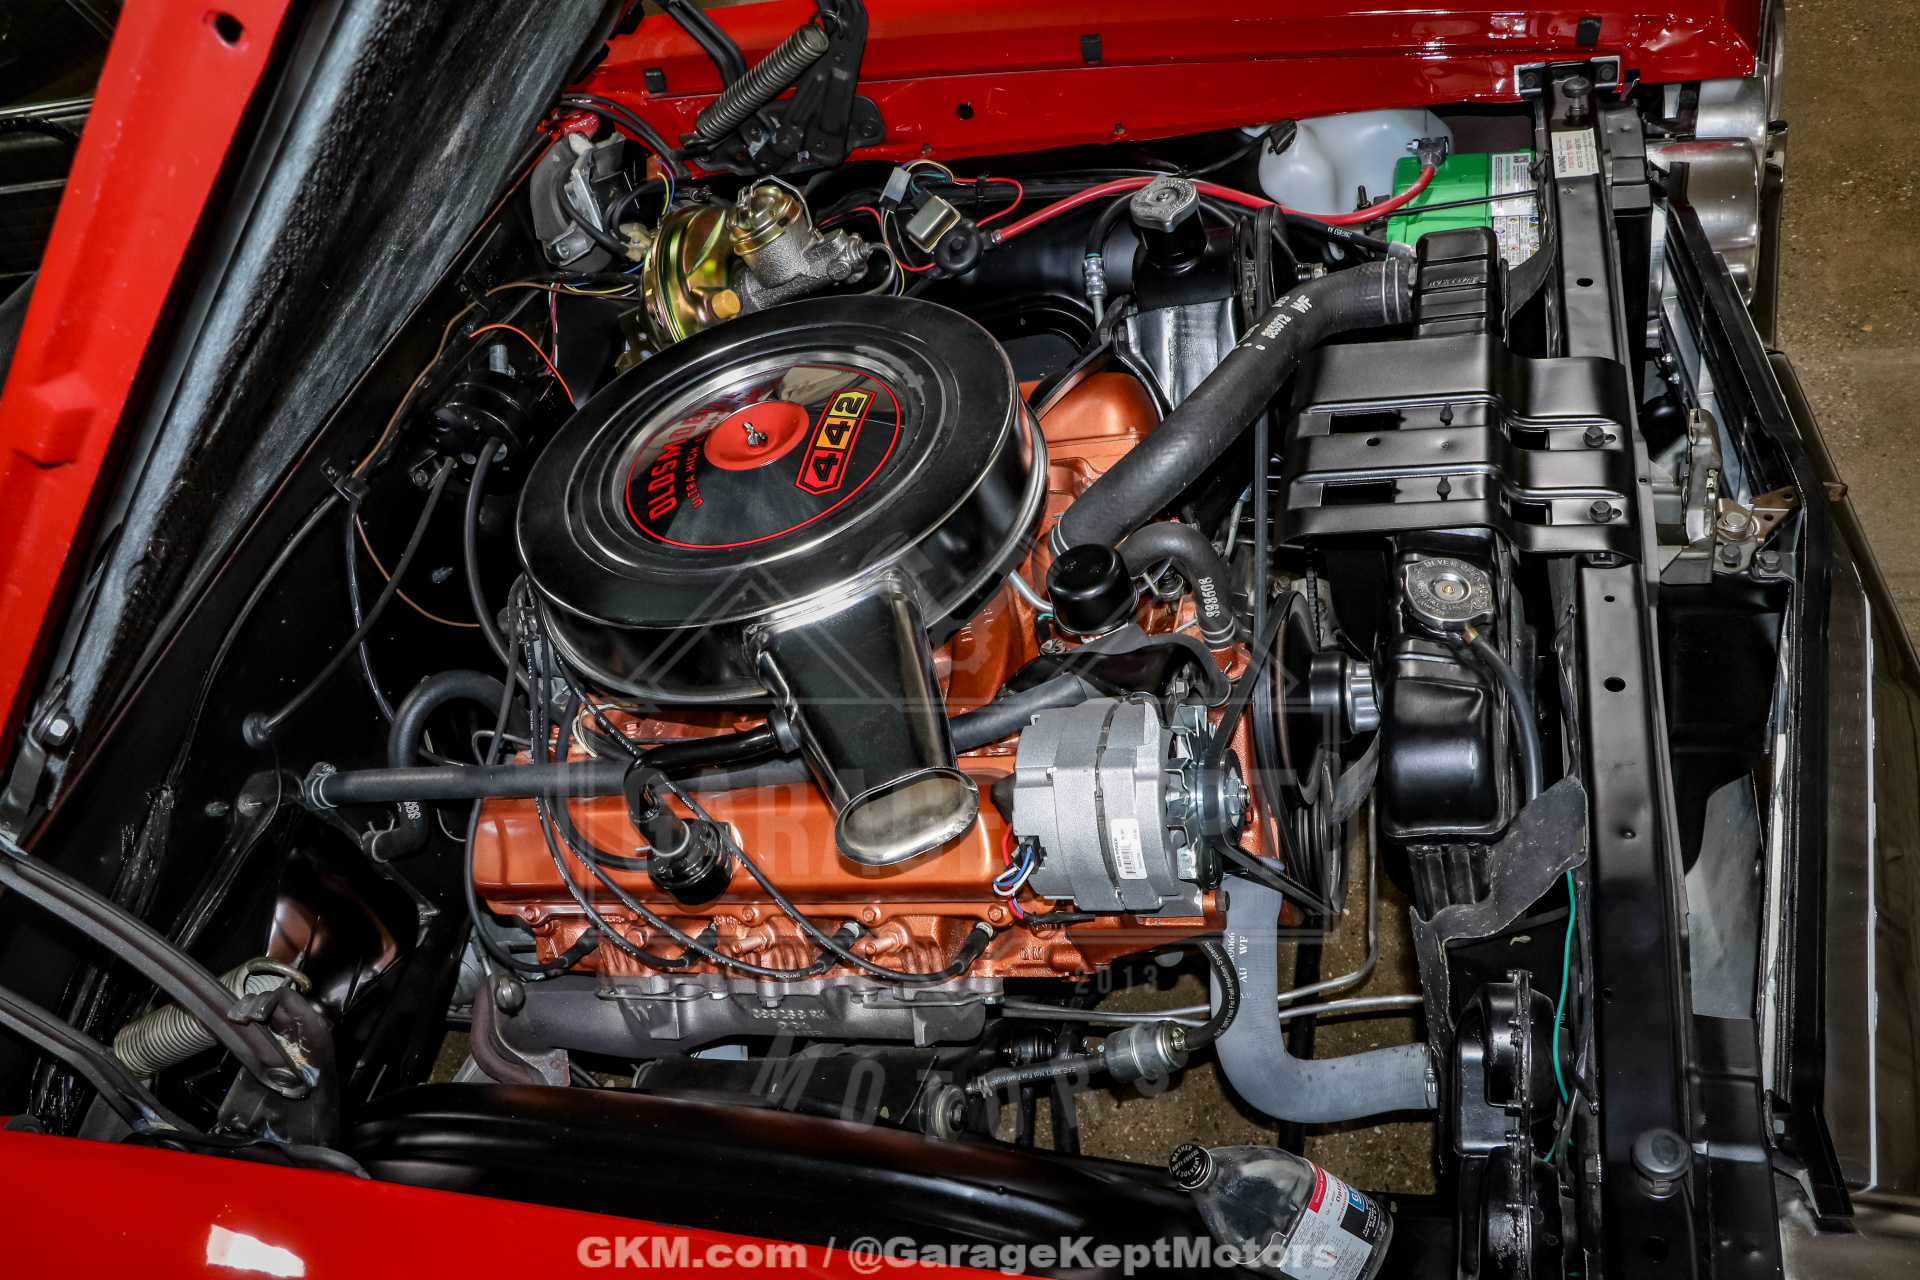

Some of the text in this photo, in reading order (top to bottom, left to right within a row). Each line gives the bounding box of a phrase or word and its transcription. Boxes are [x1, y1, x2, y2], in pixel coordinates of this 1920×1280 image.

[1558, 155, 1567, 173] WARNING
[1290, 294, 1312, 313] WF
[812, 397, 865, 482] 442
[647, 391, 742, 520] OLDSMOBILE
[686, 446, 704, 509] ULTRA HIGH
[1204, 941, 1223, 966] Systems
[1227, 933, 1236, 966] 89066
[1239, 936, 1249, 955] WF
[1220, 965, 1234, 989] Injection
[1239, 967, 1248, 983] AU
[1227, 1009, 1235, 1018] Not
[1228, 1000, 1236, 1009] For
[1007, 1074, 1021, 1083] Fuel
[1171, 1144, 1193, 1162] WASHER
[1180, 1156, 1200, 1178] SOLVENT
